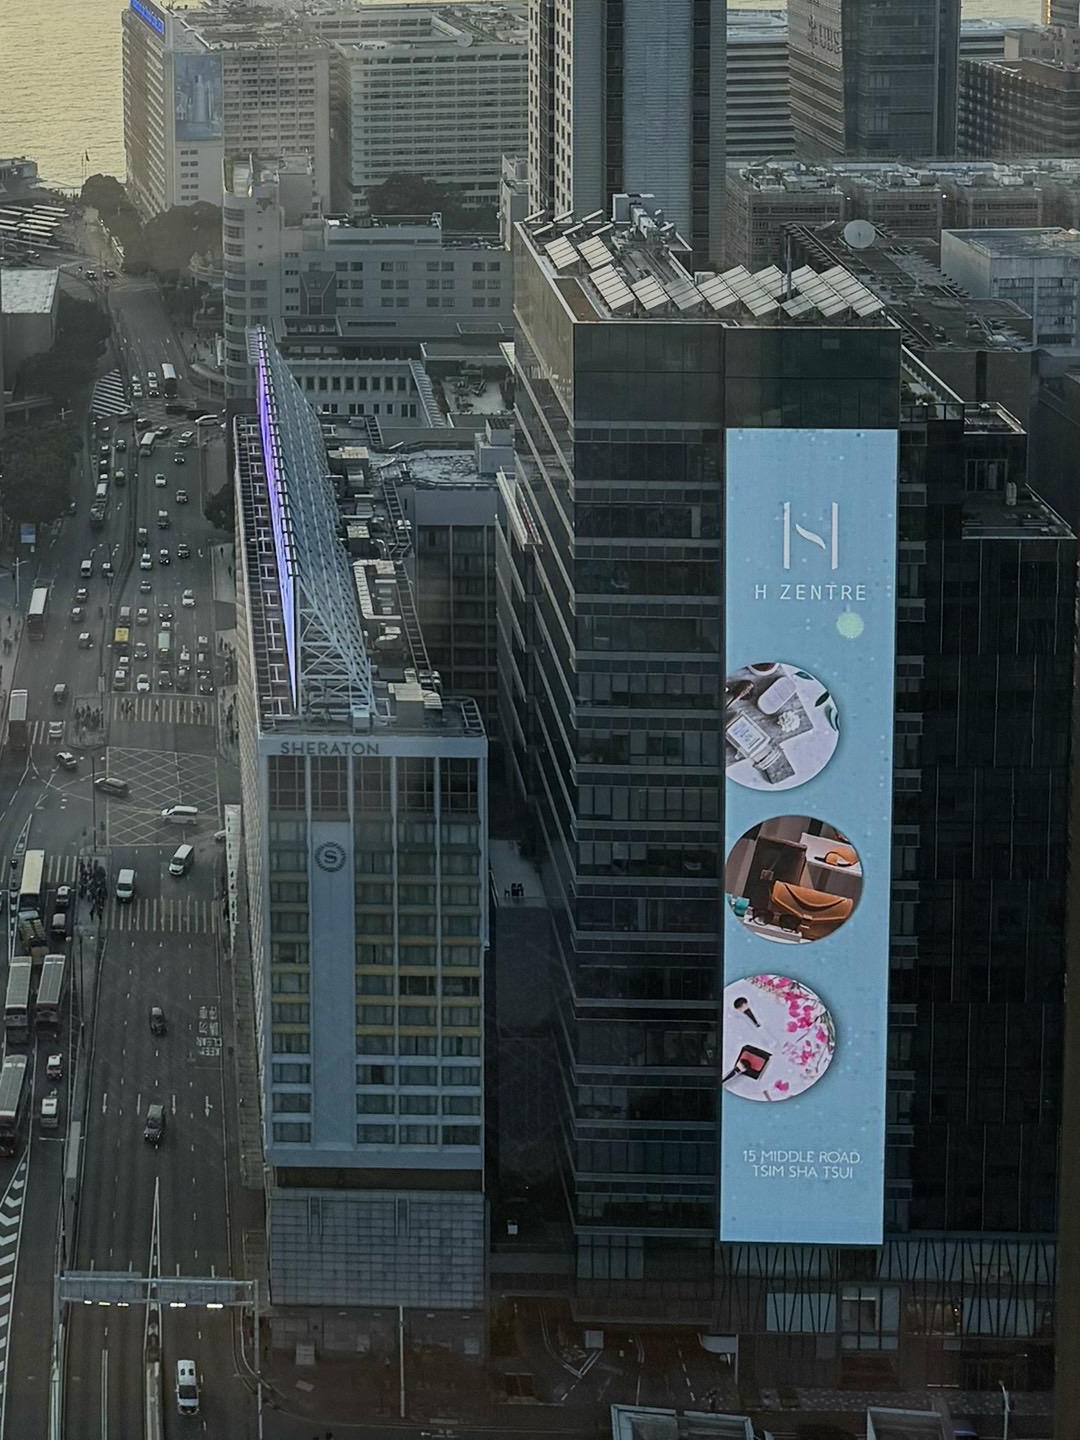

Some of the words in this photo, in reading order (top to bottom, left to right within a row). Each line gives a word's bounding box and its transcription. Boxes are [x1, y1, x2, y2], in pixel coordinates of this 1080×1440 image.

[820, 23, 840, 54] UBS
[755, 584, 767, 599] H
[780, 584, 866, 601] ZENTRE
[280, 741, 380, 755] SHERATON
[743, 1150, 756, 1163] 15
[760, 1150, 815, 1164] MIDDLE
[752, 1164, 785, 1177] TSIM
[789, 1165, 818, 1178] SHA
[823, 1166, 853, 1179] TSUI
